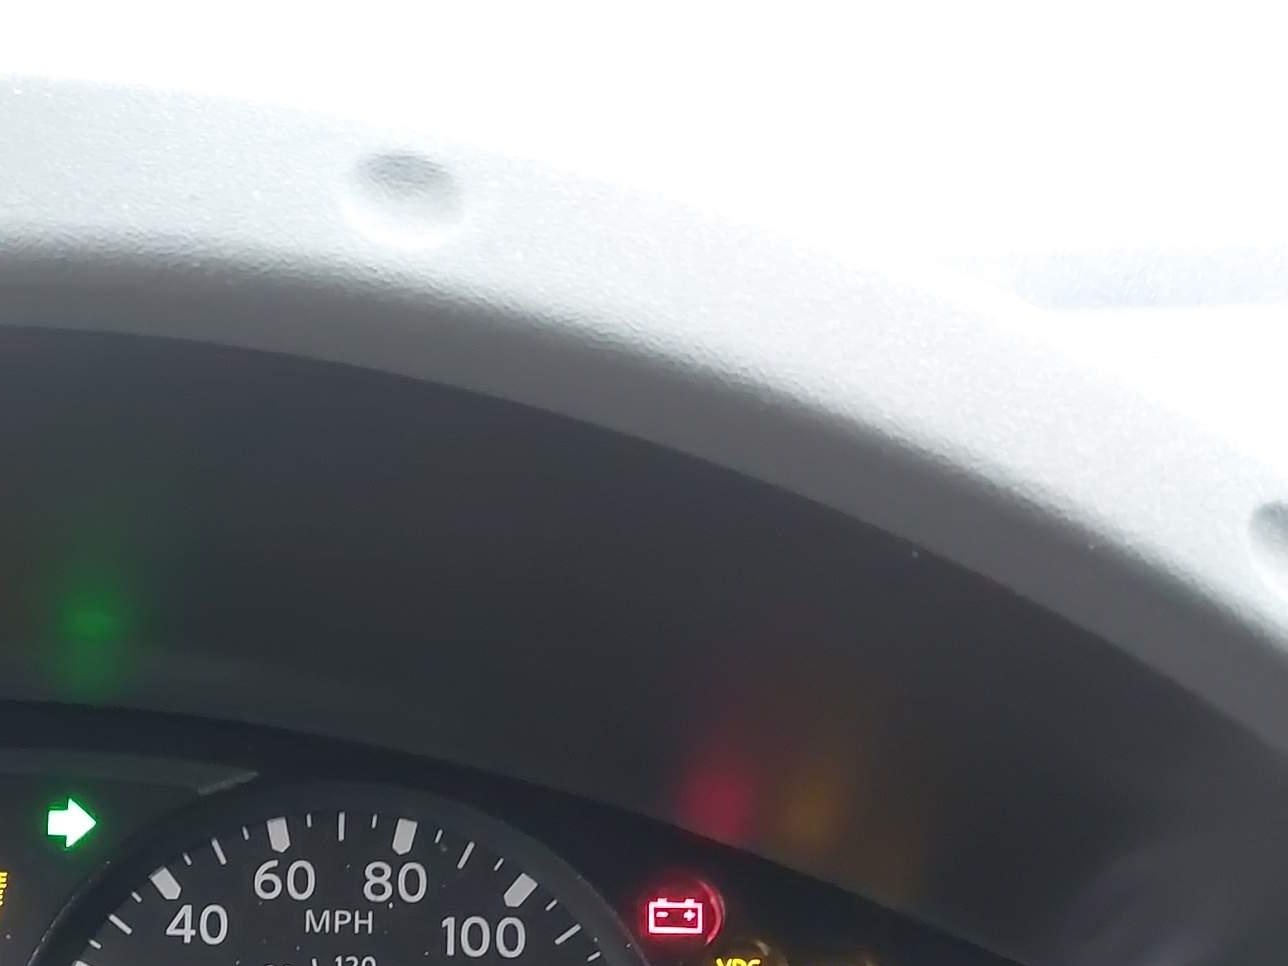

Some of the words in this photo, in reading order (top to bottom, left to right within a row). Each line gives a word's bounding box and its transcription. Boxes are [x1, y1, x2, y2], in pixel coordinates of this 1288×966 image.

[253, 859, 316, 901] 60
[363, 861, 427, 903] 80
[165, 904, 229, 945] 40
[305, 909, 373, 934] MPH
[441, 916, 526, 958] 100
